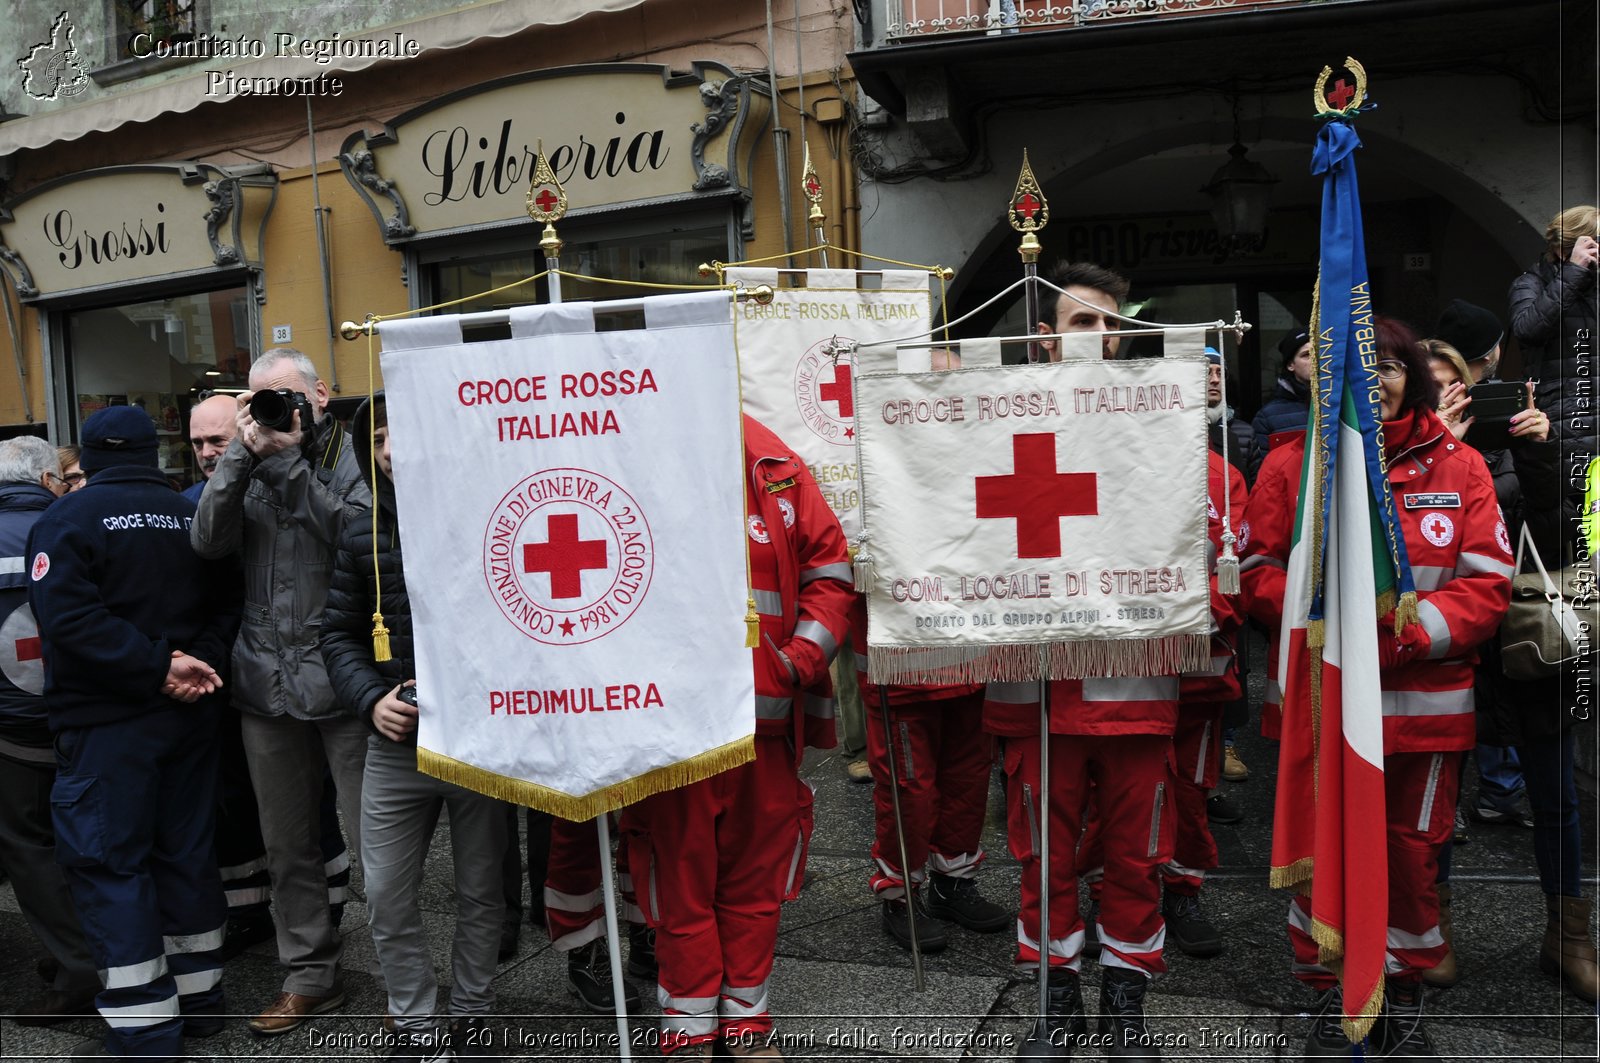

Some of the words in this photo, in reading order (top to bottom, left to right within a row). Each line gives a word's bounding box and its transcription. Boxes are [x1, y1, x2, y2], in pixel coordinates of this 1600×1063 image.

[421, 111, 671, 207] Libreria
[43, 202, 170, 270] Grossi
[1410, 256, 1425, 268] 39
[744, 303, 791, 321] CROCE
[799, 303, 851, 321] ROSSA
[857, 303, 921, 320] ITALIANA
[277, 329, 287, 340] 38
[1350, 281, 1378, 381] VERBANIA
[808, 353, 821, 369] DI
[1320, 326, 1334, 428] ITALIANA
[458, 375, 547, 407] CROCE
[561, 368, 658, 400] ROSSA
[799, 367, 839, 440] CONVENZIONE
[882, 397, 965, 425] CROCE
[977, 391, 1060, 420] ROSSA
[1074, 384, 1185, 414] ITALIANA
[498, 410, 621, 442] ITALIANA
[1320, 434, 1332, 513] OSSA
[508, 492, 531, 519] DI
[527, 476, 614, 511] GINEVRA
[103, 513, 145, 531] CROCE
[146, 514, 182, 530] ROSSA
[612, 505, 636, 530] 22
[489, 515, 555, 636] CONVENZIONE
[614, 527, 646, 605] AGOSTO
[891, 576, 950, 602] COM.
[961, 573, 1052, 601] LOCALE
[1066, 571, 1089, 597] DI
[1100, 566, 1187, 595] STRESA
[580, 601, 619, 635] 1864
[915, 615, 966, 628] DONATO
[972, 613, 996, 627] DAL
[1002, 611, 1053, 626] GRUPPO
[1060, 609, 1101, 624] ALPINI
[1117, 606, 1166, 621] STRESA
[490, 682, 664, 715] PIEDIMULERA
